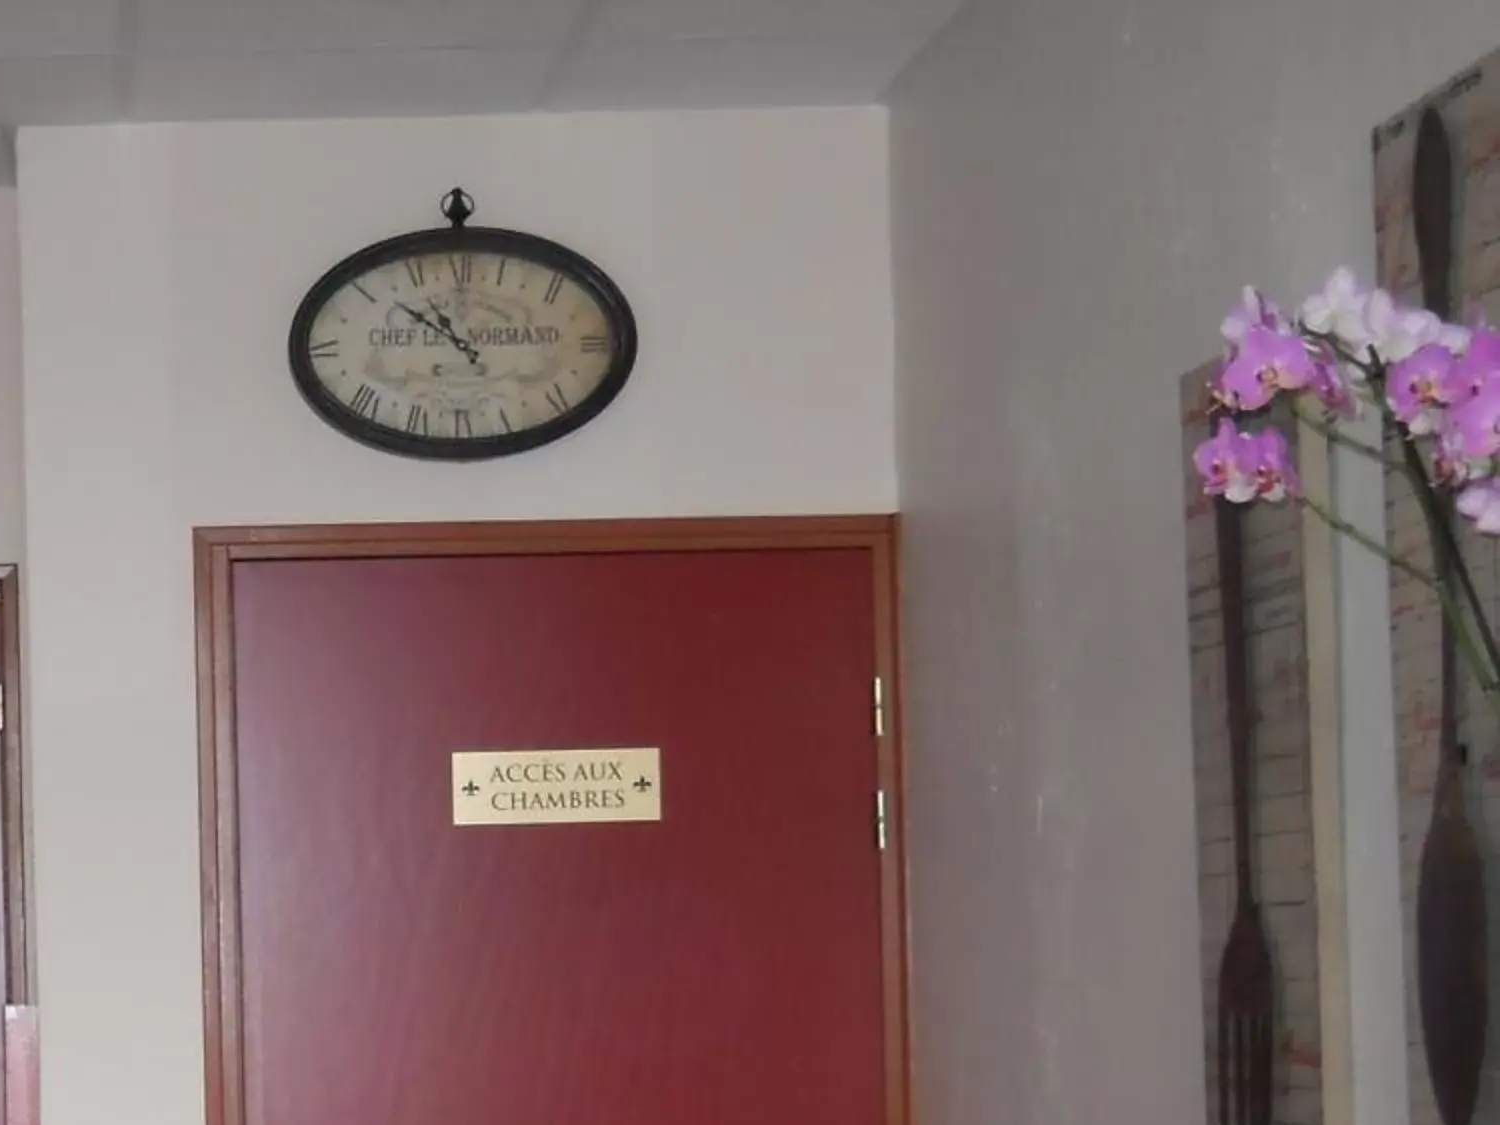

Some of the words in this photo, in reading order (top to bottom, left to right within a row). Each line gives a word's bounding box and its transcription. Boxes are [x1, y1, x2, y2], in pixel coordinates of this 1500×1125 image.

[369, 328, 416, 346] CHEF
[468, 326, 560, 346] NORMAND
[489, 760, 567, 784] ACCÈS
[573, 761, 624, 782] AUX
[490, 788, 626, 811] CHAMBRES
